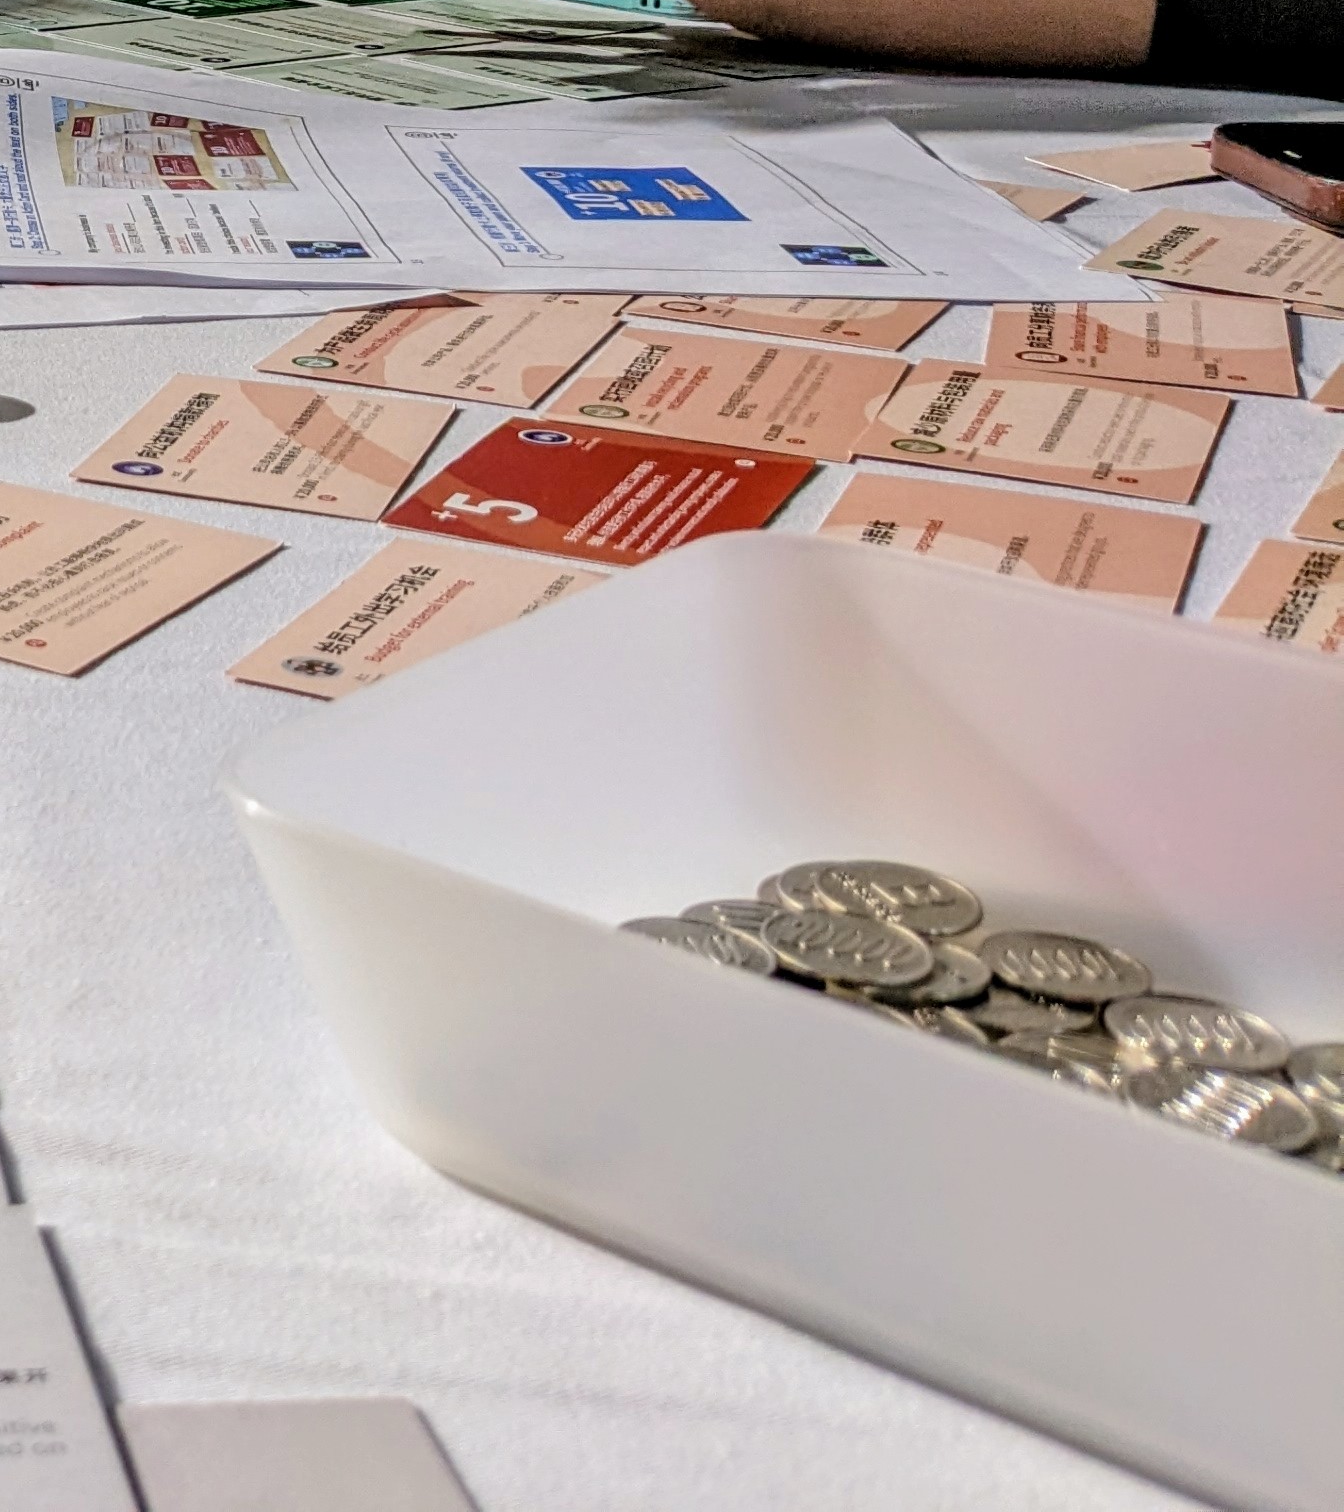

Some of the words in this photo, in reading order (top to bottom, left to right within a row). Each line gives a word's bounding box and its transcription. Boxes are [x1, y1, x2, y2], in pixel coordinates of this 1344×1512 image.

[313, 564, 440, 655] 给员工外出学习机会
